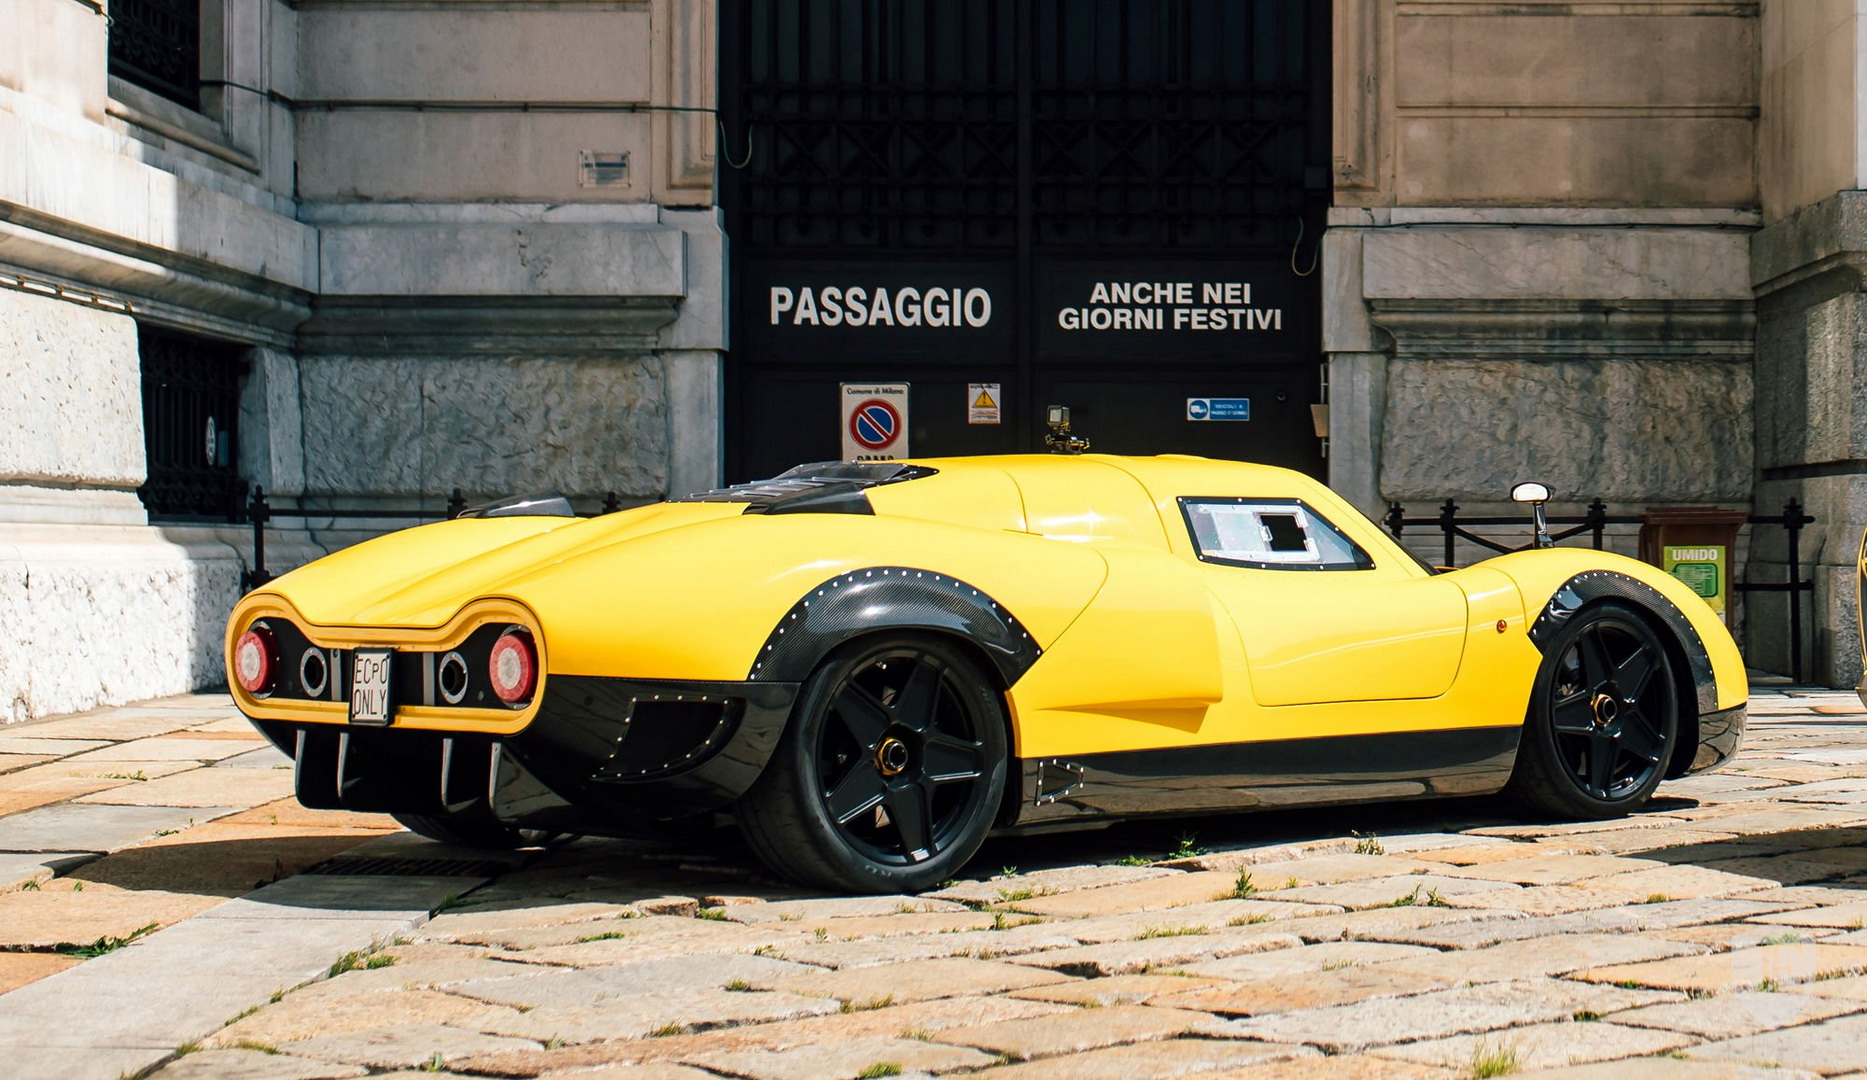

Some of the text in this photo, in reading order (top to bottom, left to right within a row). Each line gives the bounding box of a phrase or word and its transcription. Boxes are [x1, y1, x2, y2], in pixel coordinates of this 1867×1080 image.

[1089, 282, 1251, 305] ANCHE NEI
[770, 286, 992, 328] PASSAGGIO
[1058, 307, 1282, 330] GIORNI FESTIVI
[846, 386, 905, 395] Comune di Milano
[1673, 549, 1717, 561] UMIDO
[354, 689, 386, 715] ONLY
